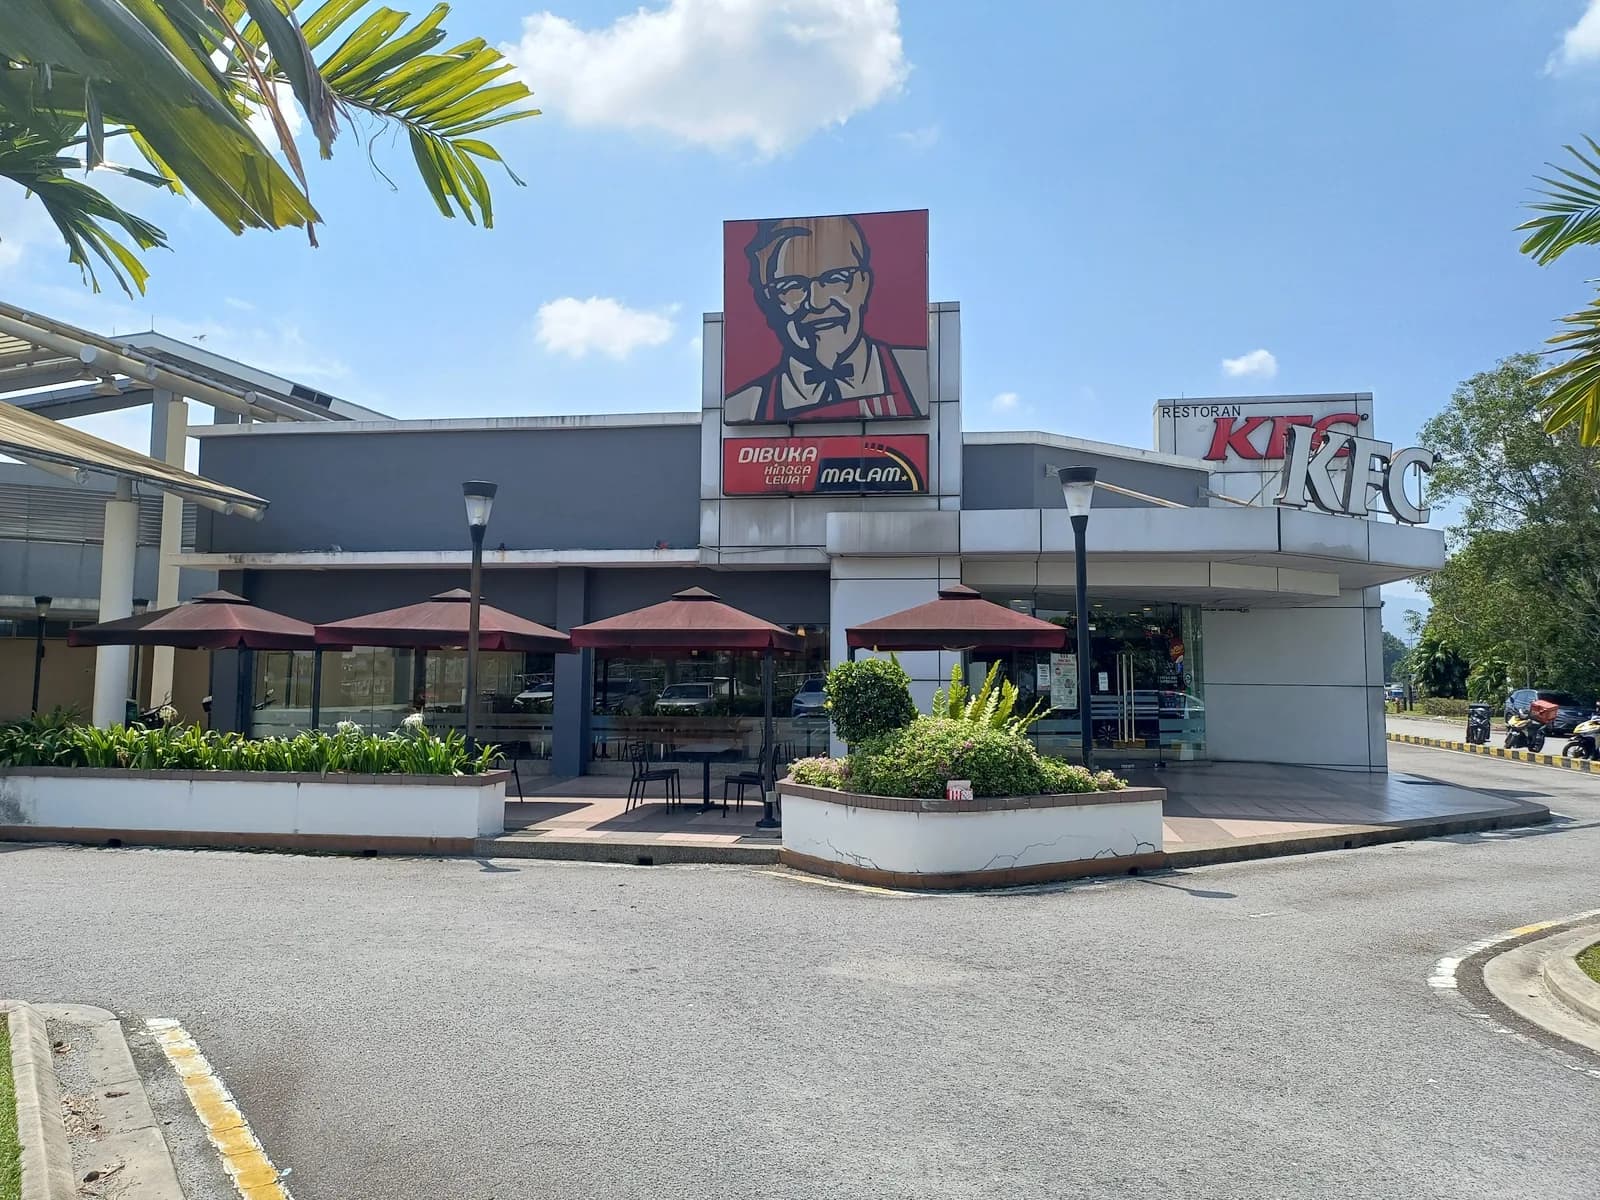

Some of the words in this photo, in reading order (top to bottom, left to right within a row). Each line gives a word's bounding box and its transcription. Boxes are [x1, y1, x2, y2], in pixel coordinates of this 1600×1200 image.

[1162, 405, 1241, 418] RESTORAN
[738, 446, 818, 464] DIBUKA
[765, 475, 809, 485] LEWAT
[820, 467, 901, 483] MALAM
[1273, 424, 1434, 524] KFC
